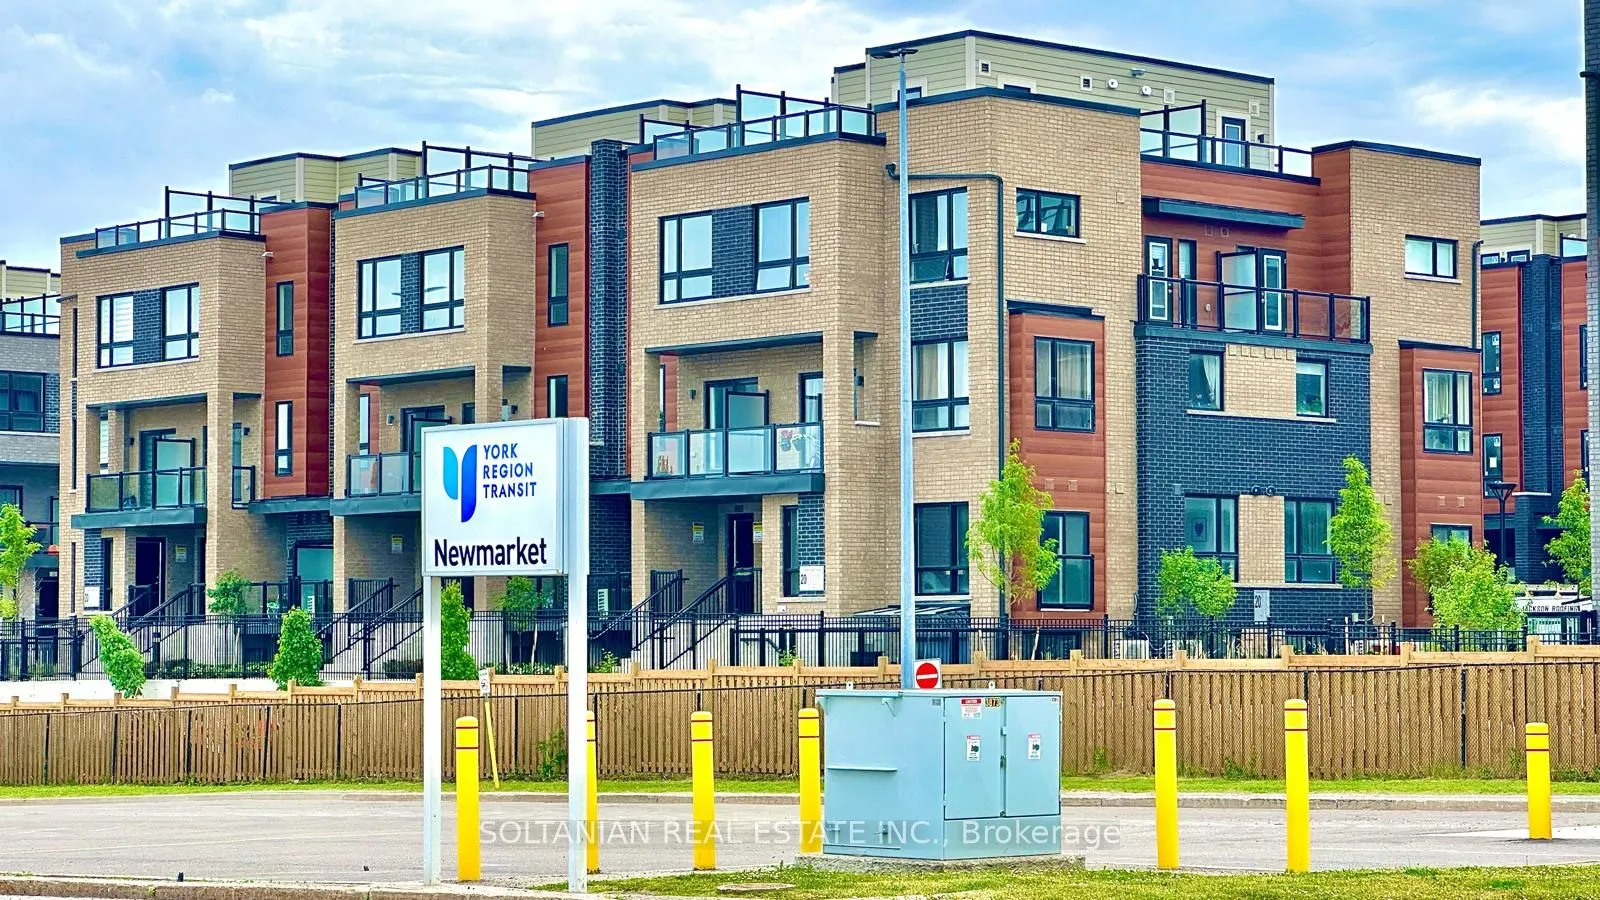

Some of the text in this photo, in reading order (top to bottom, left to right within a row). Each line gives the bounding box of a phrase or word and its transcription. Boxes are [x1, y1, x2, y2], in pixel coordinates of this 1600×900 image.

[483, 443, 518, 460] YORK
[483, 462, 533, 479] REGION
[483, 482, 537, 499] TRANSIT
[434, 537, 547, 567] Newmarket
[1254, 594, 1262, 608] 20
